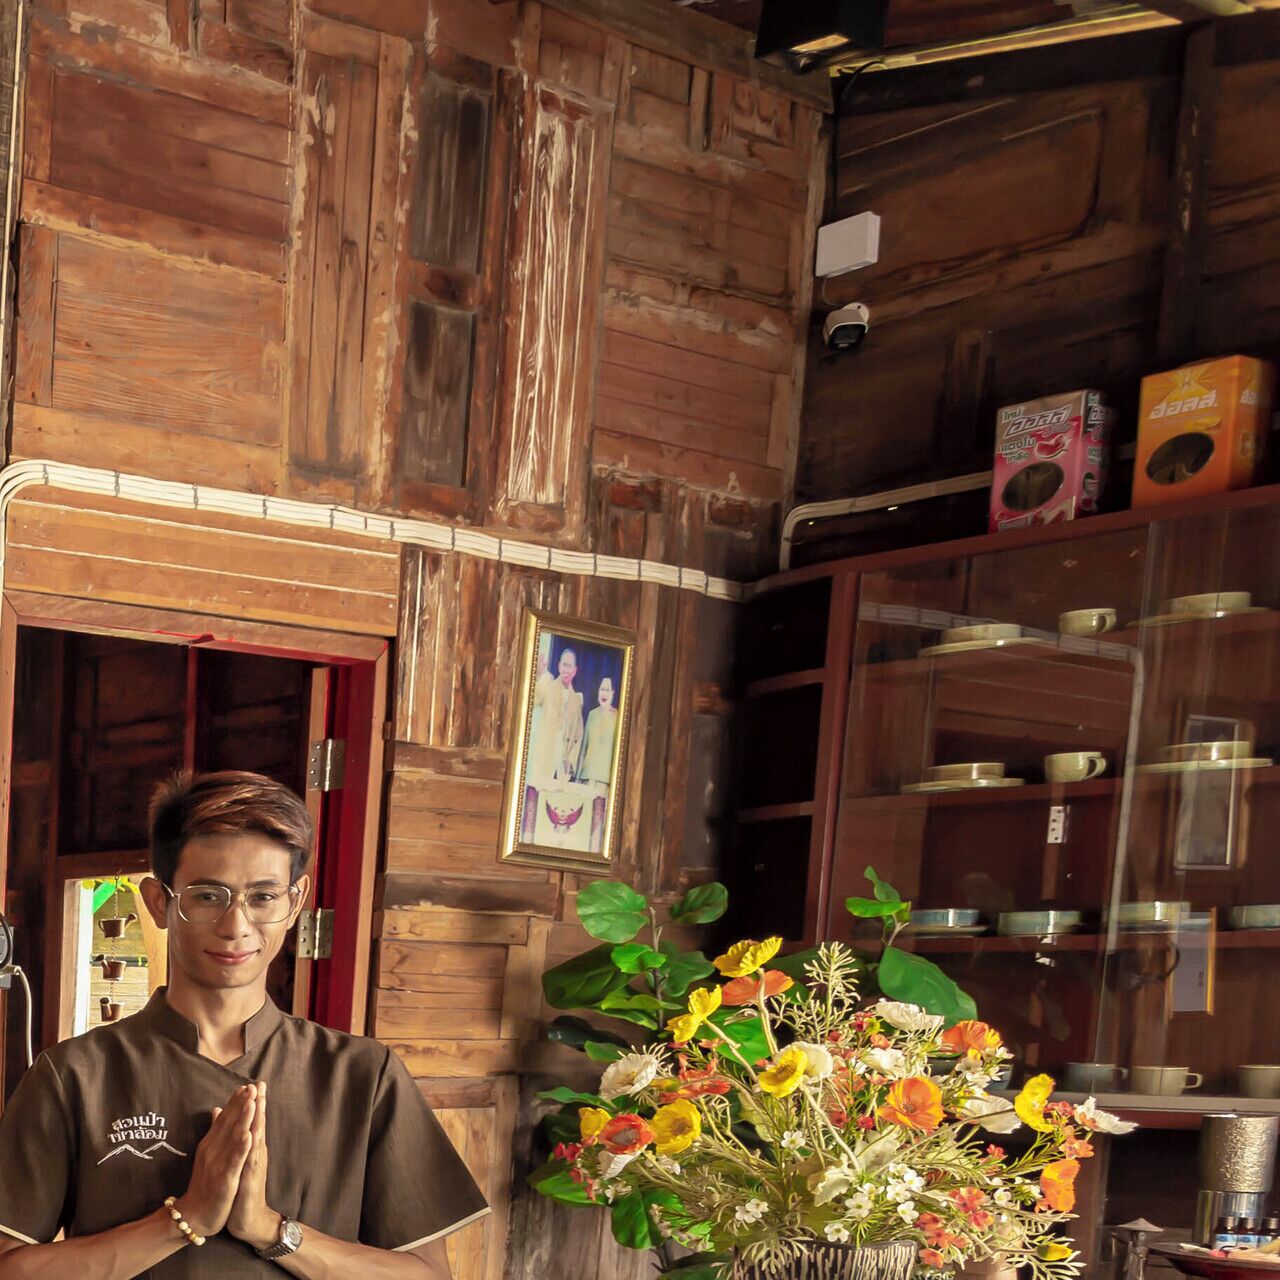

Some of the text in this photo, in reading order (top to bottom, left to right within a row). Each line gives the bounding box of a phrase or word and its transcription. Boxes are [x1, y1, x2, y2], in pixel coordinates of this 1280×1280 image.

[111, 1111, 166, 1130] สวนป่า
[107, 1125, 169, 1144] เขาล้อม
